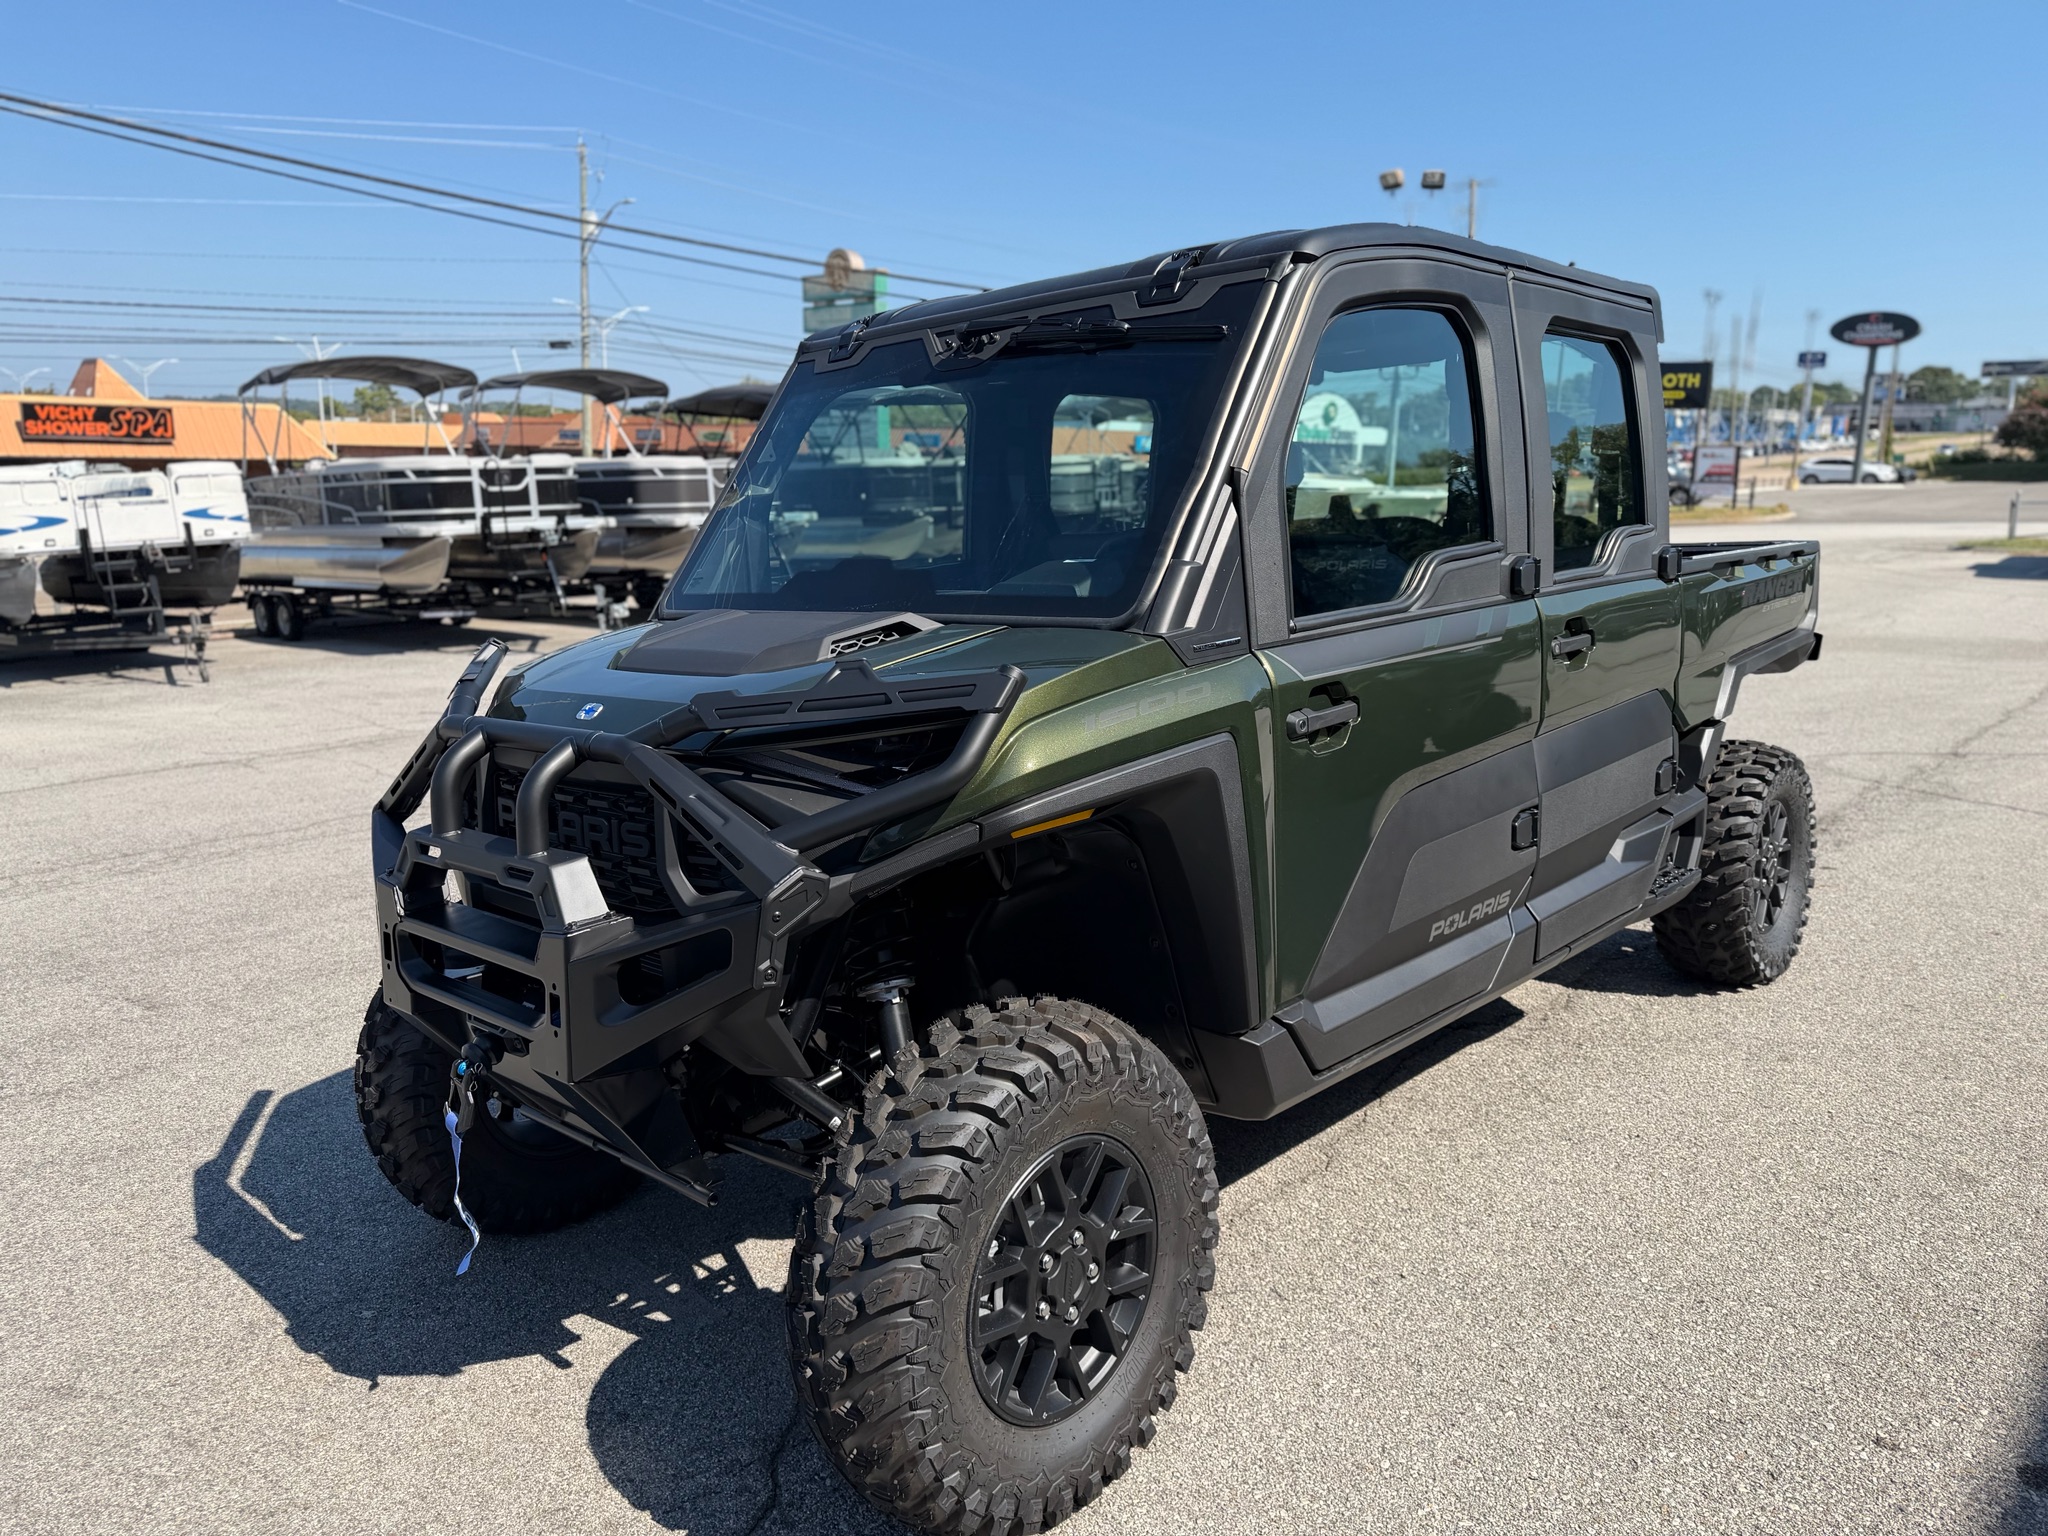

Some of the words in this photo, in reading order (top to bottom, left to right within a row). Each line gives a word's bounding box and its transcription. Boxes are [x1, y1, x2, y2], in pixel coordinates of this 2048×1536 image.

[25, 419, 109, 436] SHOWER
[34, 405, 96, 421] VICHY
[109, 407, 173, 438] SPA
[1314, 558, 1388, 573] POLARIS
[1741, 570, 1804, 609] RANGER
[497, 796, 650, 858] PARIS
[1428, 889, 1511, 943] POLARIS
[1112, 1301, 1168, 1401] KENDA
